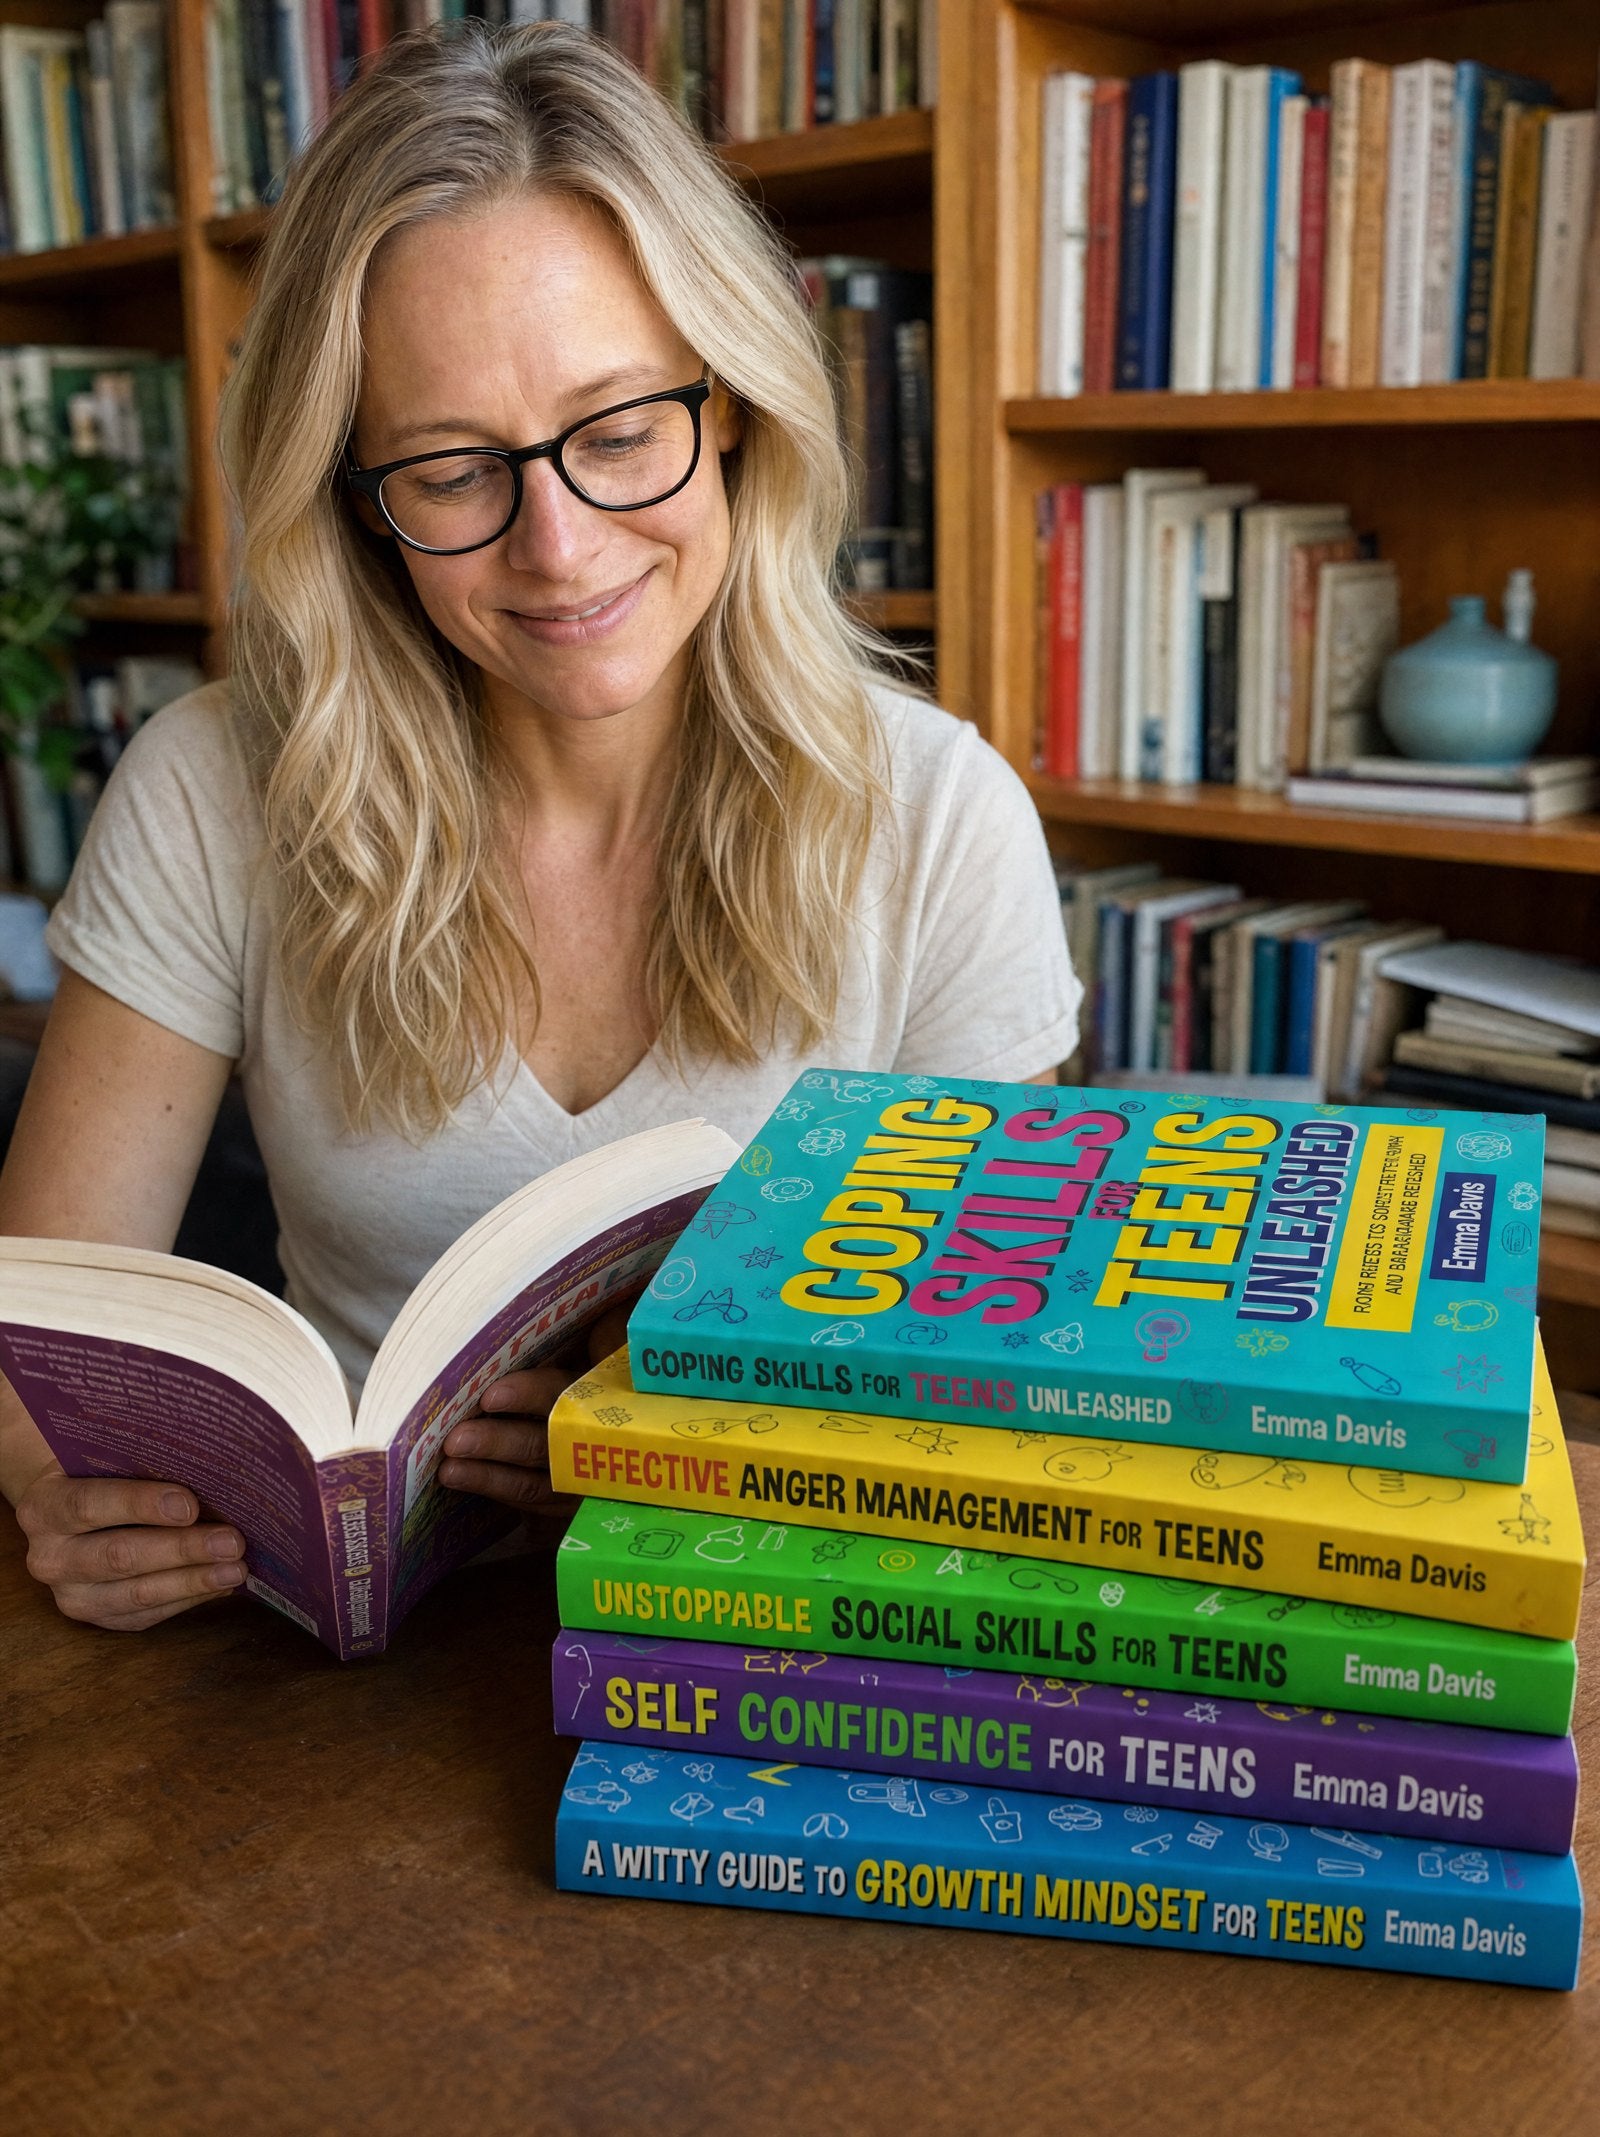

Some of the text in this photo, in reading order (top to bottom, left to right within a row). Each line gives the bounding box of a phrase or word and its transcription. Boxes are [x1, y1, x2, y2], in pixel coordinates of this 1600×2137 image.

[779, 1096, 999, 1317] COPING
[908, 1108, 1131, 1325] SKILLS
[1088, 1179, 1144, 1221] FOR
[1093, 1110, 1283, 1308] TEENS
[1235, 1119, 1360, 1323] UNLEASHED
[1441, 1180, 1486, 1271] Emma Davis
[642, 1347, 1407, 1449] COPING SKILLS FOR TEENS UNLEASHED Emma Davis
[572, 1442, 1487, 1593] EFFECTIVE ANGER MANAGEMENT FOR TEENS Emma Davis
[592, 1578, 1496, 1701] UNSTOPPABLE SOCIAL SKILLS FOR TEENS Emma Davis
[604, 1676, 1484, 1821] SELF CONFIDENCE FOR TEENS Emma Davis
[582, 1839, 1527, 1957] A WITTY GUIDE TO GROWTH MINDSET FOR TEENS Emma Davis
